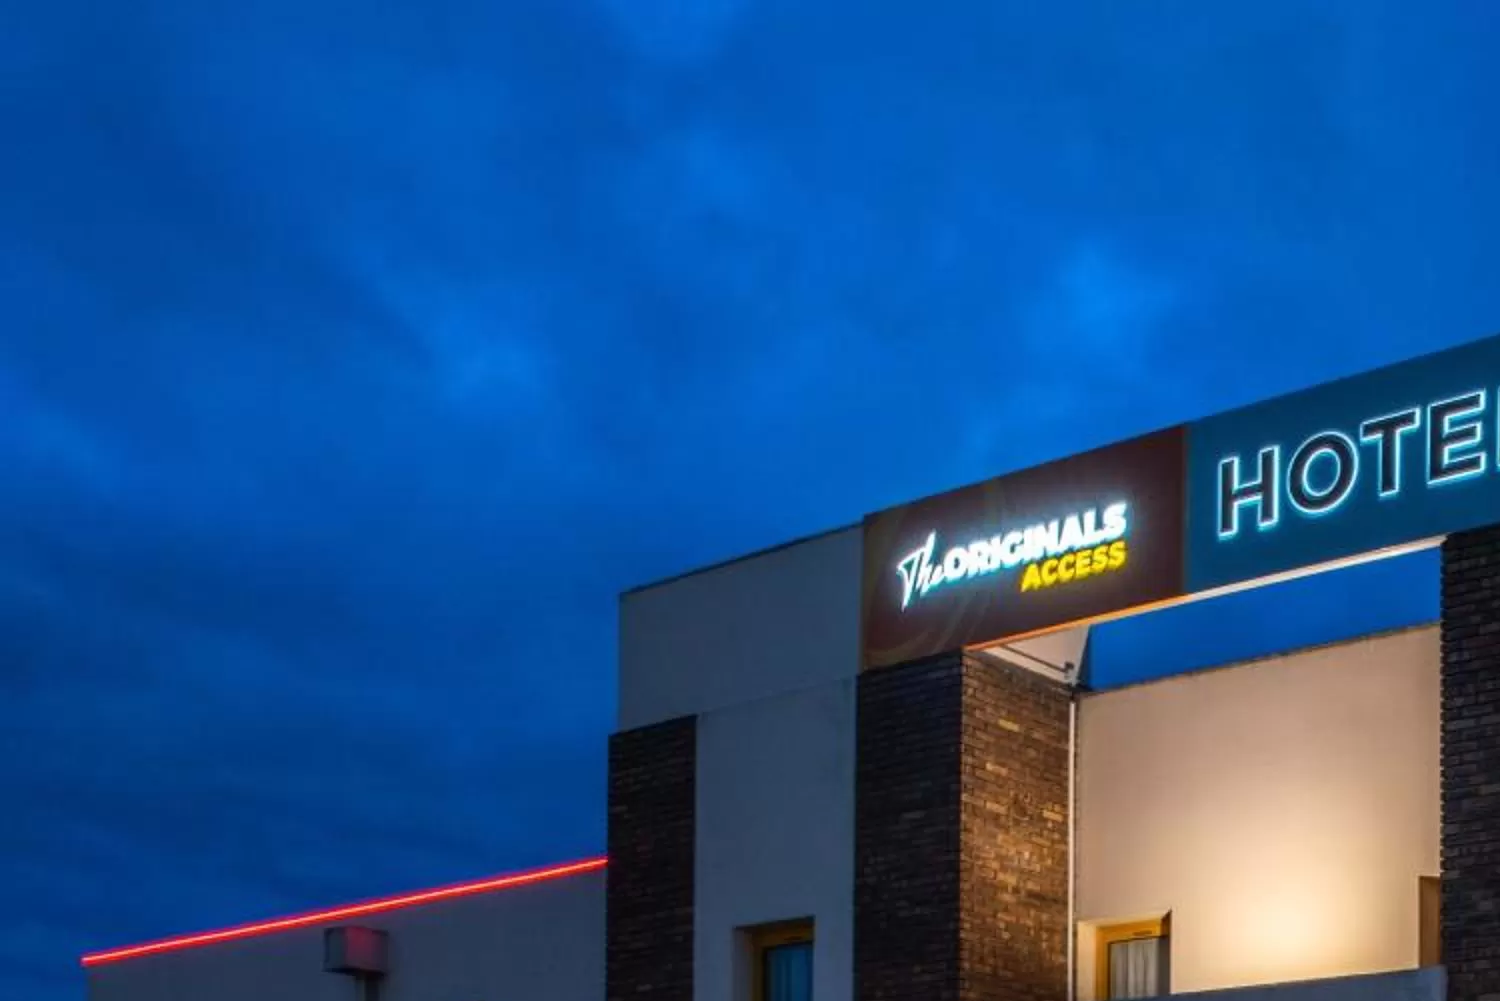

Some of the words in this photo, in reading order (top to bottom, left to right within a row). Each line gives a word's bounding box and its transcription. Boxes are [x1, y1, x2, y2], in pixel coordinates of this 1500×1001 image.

[897, 529, 945, 612] The
[944, 502, 1127, 581] ORIGINALS
[1020, 541, 1126, 592] ACCESS
